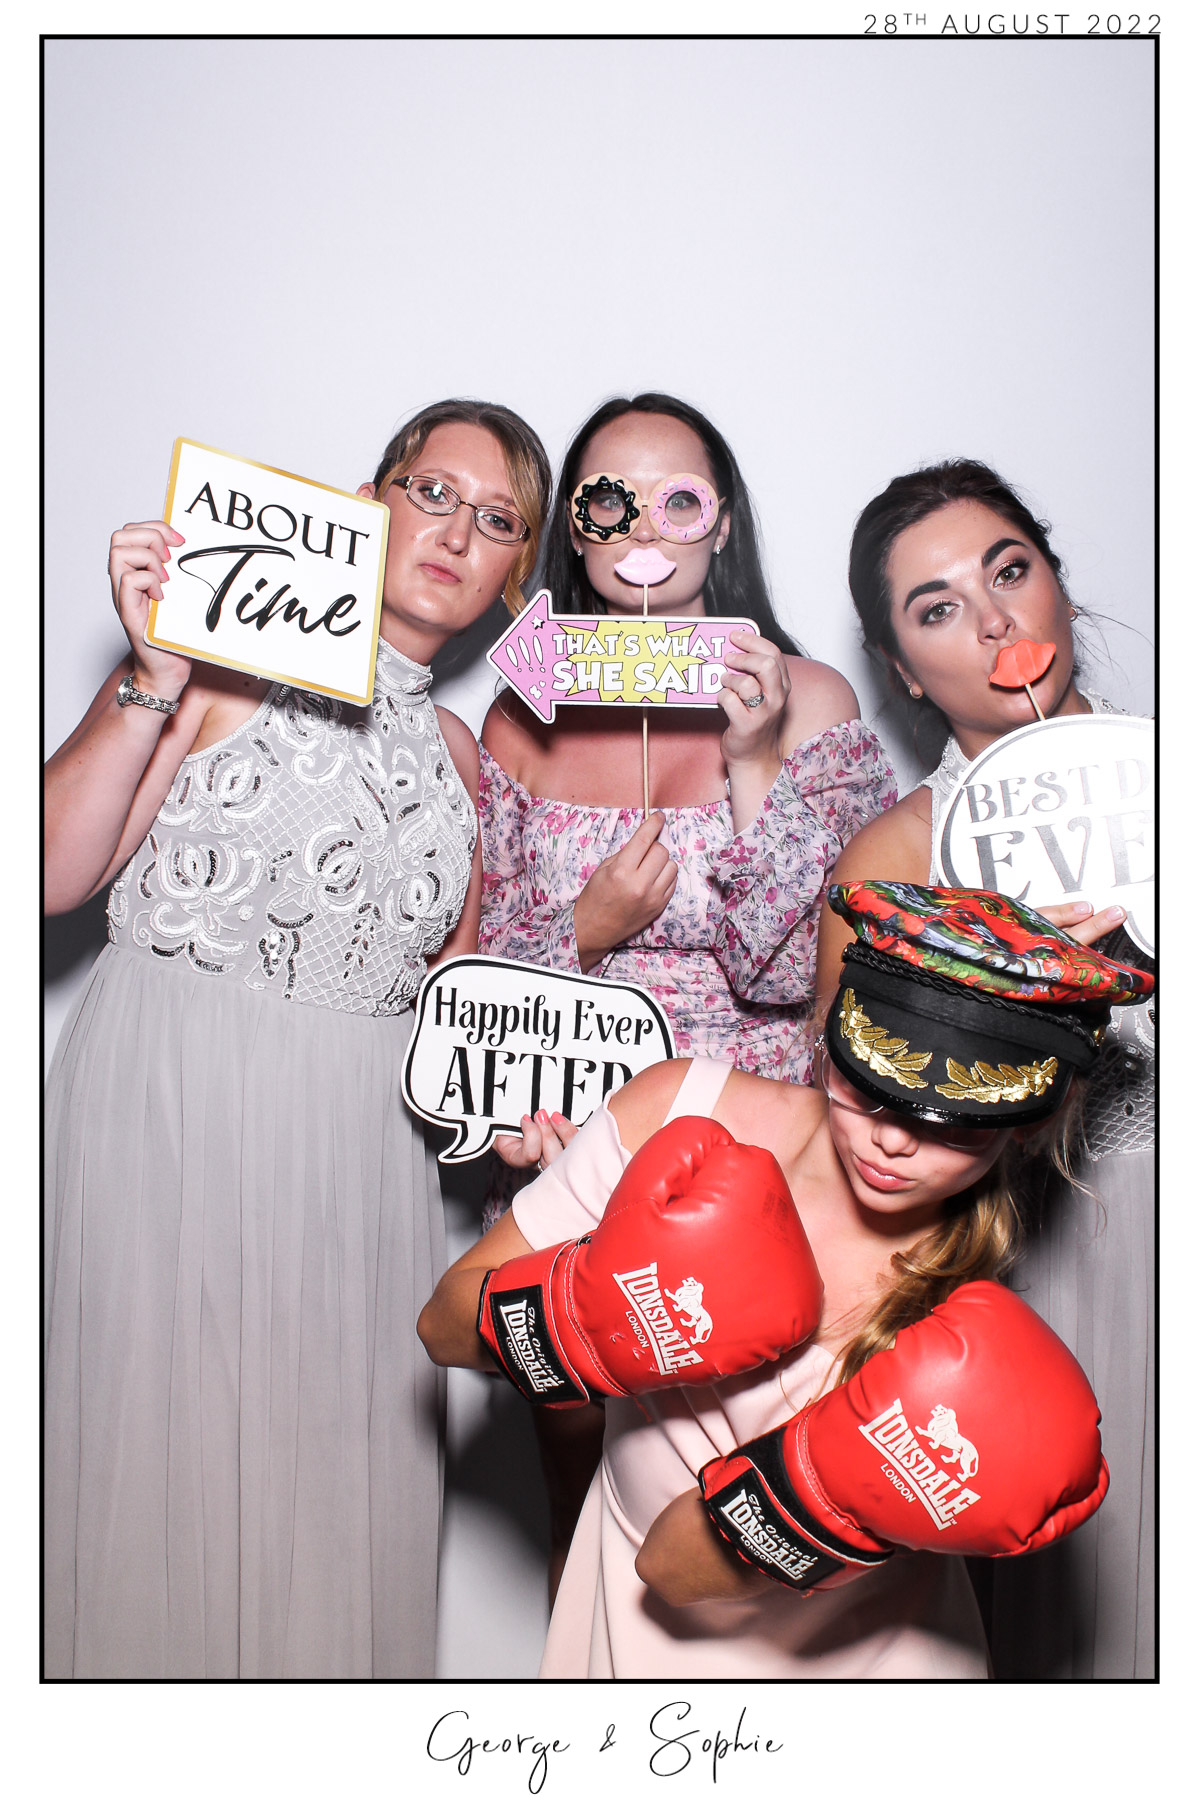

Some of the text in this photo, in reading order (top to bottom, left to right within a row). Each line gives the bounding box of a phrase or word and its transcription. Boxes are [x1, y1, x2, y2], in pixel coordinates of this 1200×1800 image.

[184, 481, 370, 567] ABOUT
[177, 544, 361, 637] Time
[552, 631, 726, 658] THAT'S WHAT
[552, 661, 727, 694] SHE SAID
[964, 764, 1100, 824] BEST
[434, 986, 654, 1051] Happily Ever
[500, 1299, 560, 1393] LONSDALE
[612, 1262, 704, 1376] LONSDALE
[625, 1310, 650, 1348] LONDON
[506, 1336, 524, 1371] LONDON
[858, 1398, 981, 1531] LONSDALE
[880, 1463, 916, 1503] LONDON
[720, 1488, 815, 1581] LONSDALE
[741, 1534, 773, 1565] LONDON
